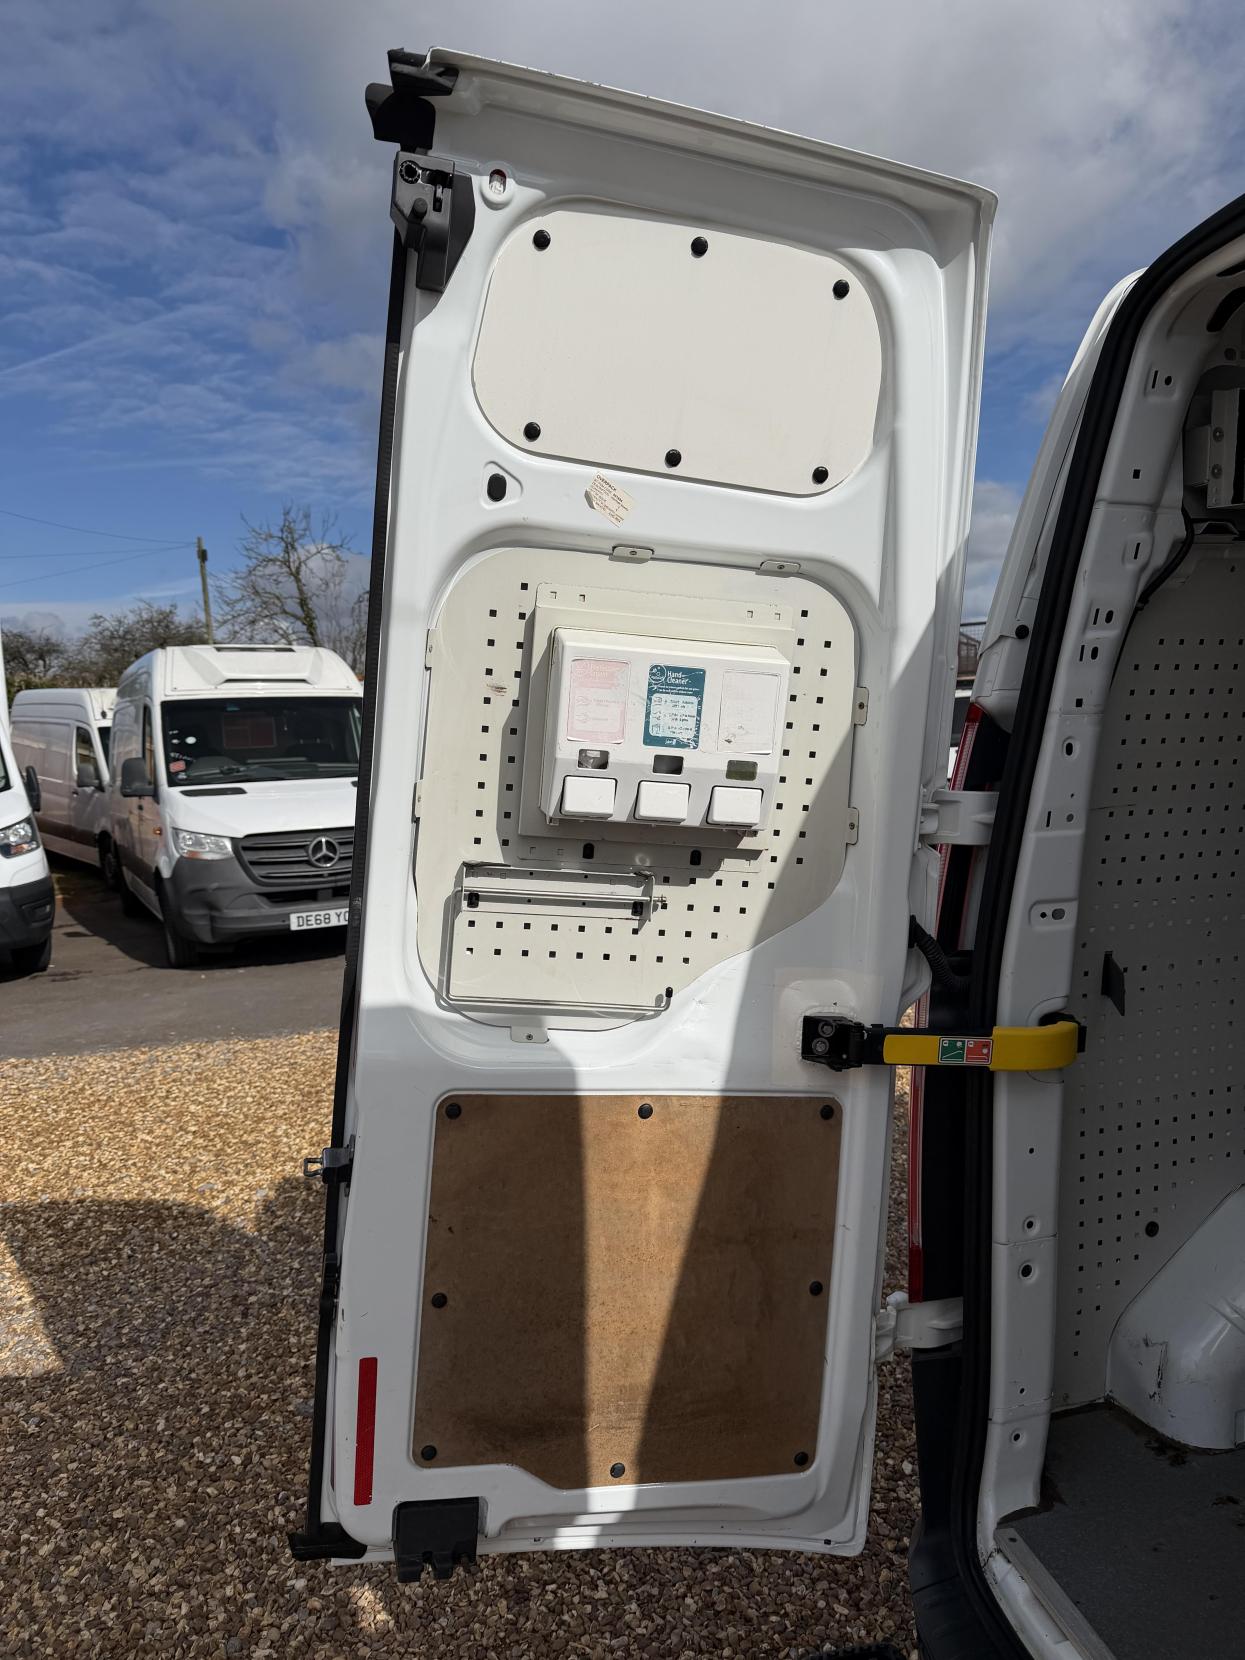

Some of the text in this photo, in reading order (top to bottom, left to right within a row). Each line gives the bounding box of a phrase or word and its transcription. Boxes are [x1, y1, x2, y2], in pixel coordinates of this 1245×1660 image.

[667, 670, 682, 678] Hand
[666, 676, 688, 685] Cleaner
[297, 912, 331, 927] DE68
